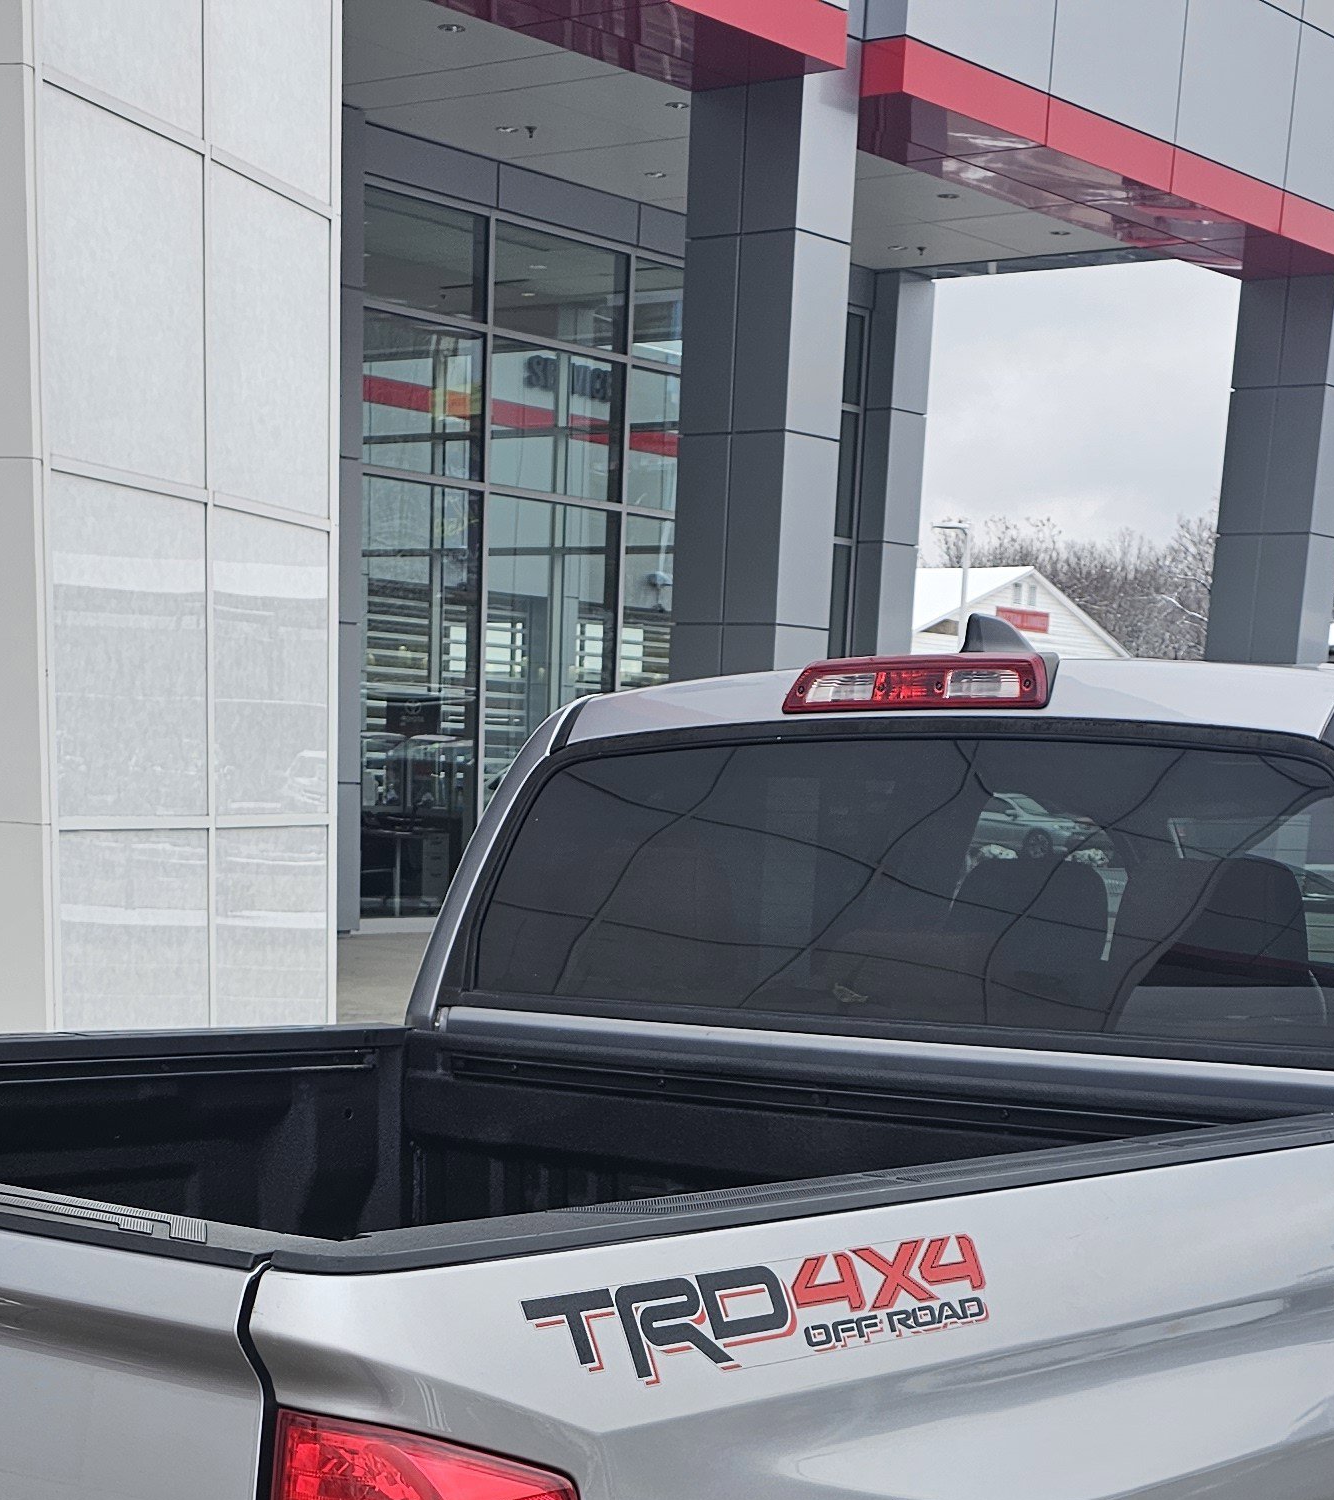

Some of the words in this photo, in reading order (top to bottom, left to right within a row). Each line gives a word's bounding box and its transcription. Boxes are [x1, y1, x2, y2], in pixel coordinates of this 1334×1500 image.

[520, 1264, 796, 1386] TRD
[791, 1233, 986, 1312] 4X4
[804, 1312, 883, 1350] OFF
[886, 1296, 989, 1336] ROAD
